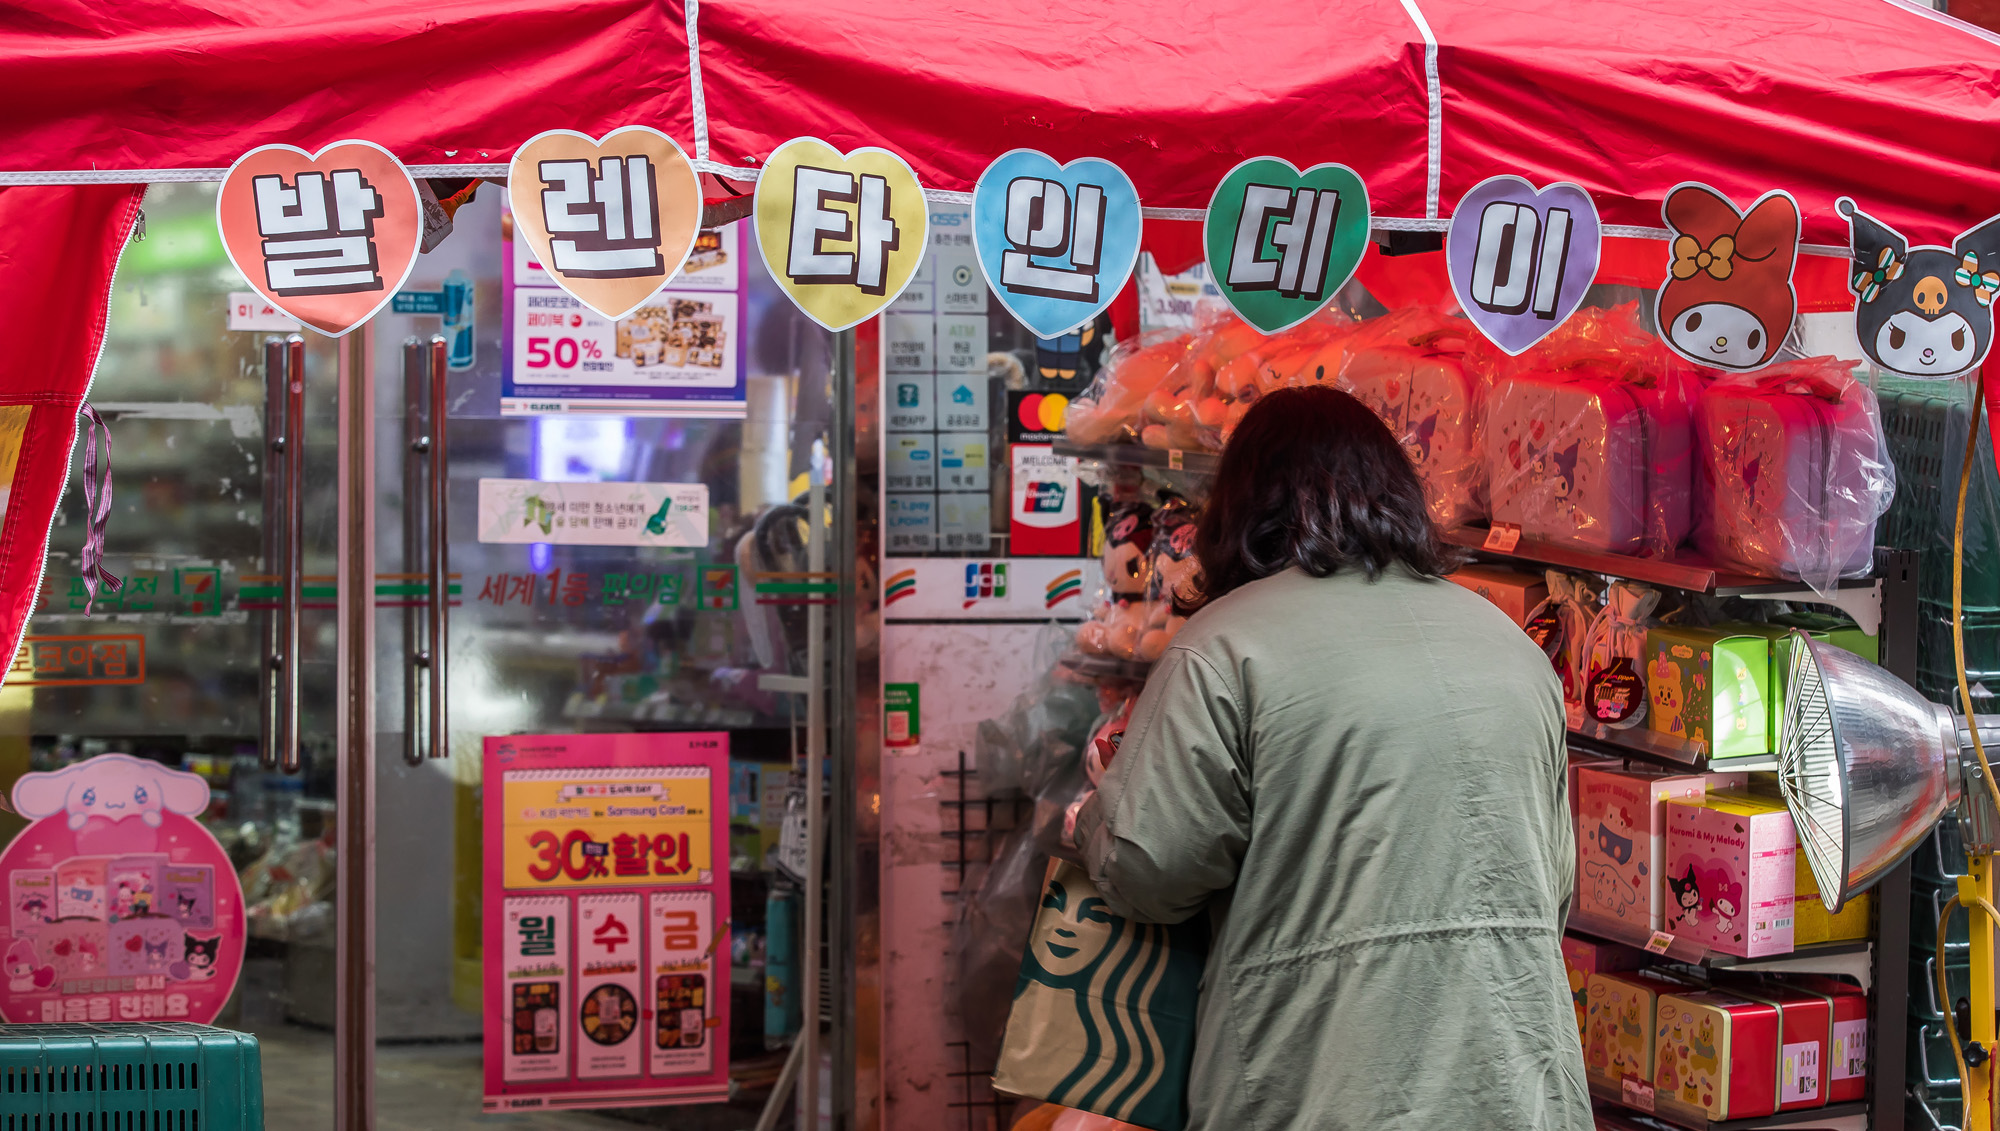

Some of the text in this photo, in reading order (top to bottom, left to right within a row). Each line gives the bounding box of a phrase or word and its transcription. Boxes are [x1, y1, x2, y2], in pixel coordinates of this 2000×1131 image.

[252, 154, 1574, 320] 발 렌 타 인 데 이
[949, 325, 975, 336] ATM
[527, 337, 602, 369] 50%
[478, 567, 683, 607] 세계 1등 편의점
[965, 568, 1006, 593] JCB
[607, 805, 657, 818] Samsung
[659, 804, 686, 815] Card
[612, 832, 692, 876] 할인
[1669, 823, 1696, 839] Kuromi
[1703, 832, 1715, 844] My
[1716, 835, 1746, 849] Melody
[518, 915, 556, 956] 월
[593, 912, 629, 953] 수
[663, 910, 698, 950] 금
